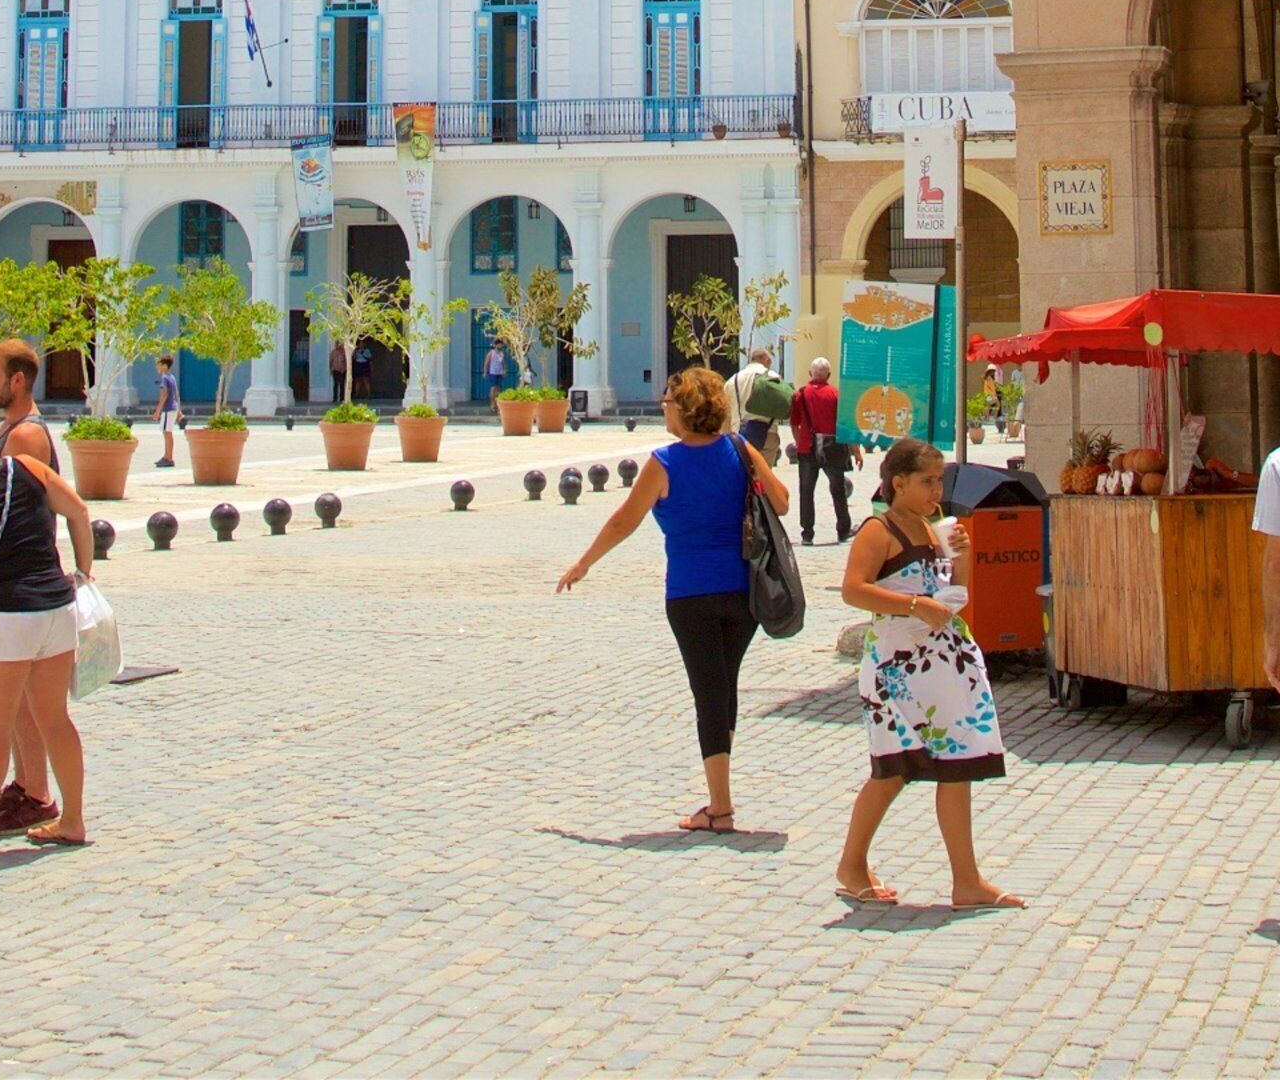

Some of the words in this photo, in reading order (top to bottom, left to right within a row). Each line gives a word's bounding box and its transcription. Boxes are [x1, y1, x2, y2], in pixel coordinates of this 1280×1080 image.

[897, 95, 974, 121] CUBA
[1053, 179, 1096, 194] PLAZA
[1055, 201, 1095, 216] VIEJA
[942, 312, 953, 353] HABANA
[976, 548, 1040, 564] PLÁSTICO
